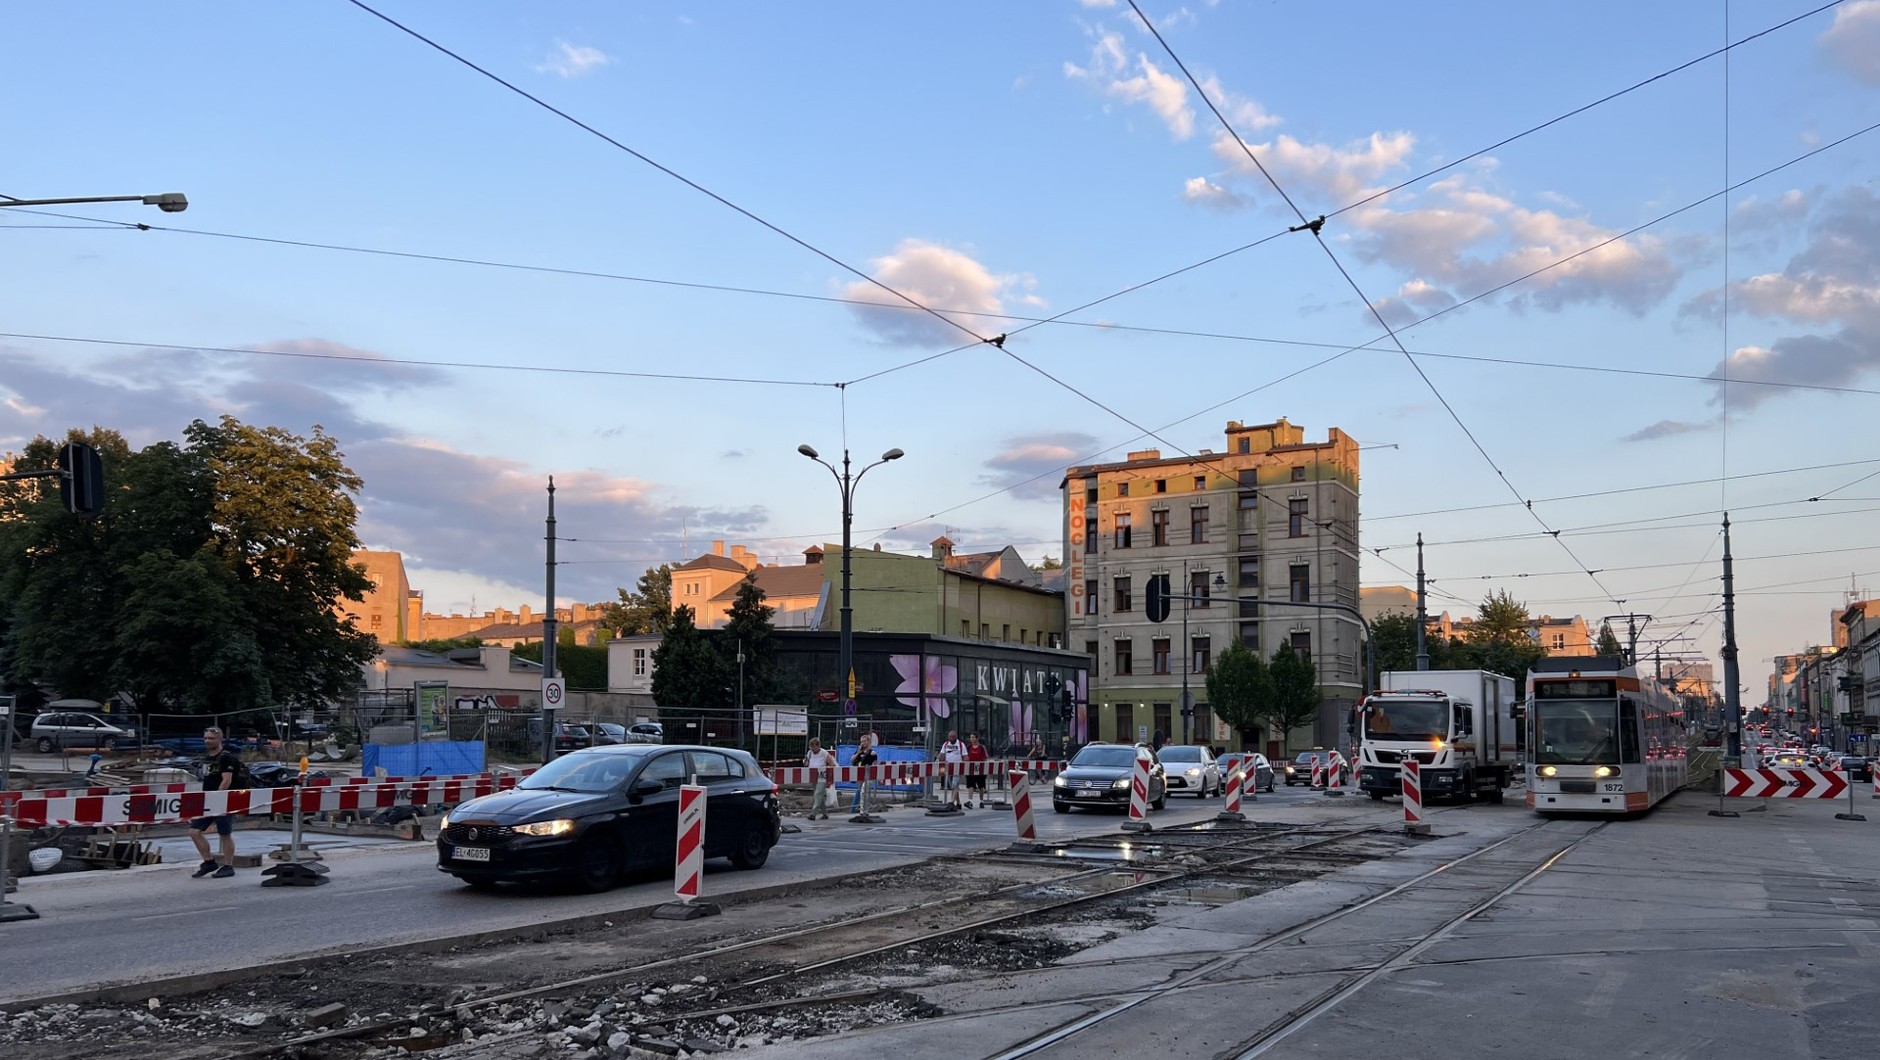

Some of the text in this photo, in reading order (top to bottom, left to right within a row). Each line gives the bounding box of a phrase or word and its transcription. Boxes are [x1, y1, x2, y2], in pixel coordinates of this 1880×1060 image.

[1070, 498, 1085, 614] NOCLEGI
[548, 688, 559, 698] 30
[1604, 784, 1624, 792] 1872
[456, 848, 464, 857] EL
